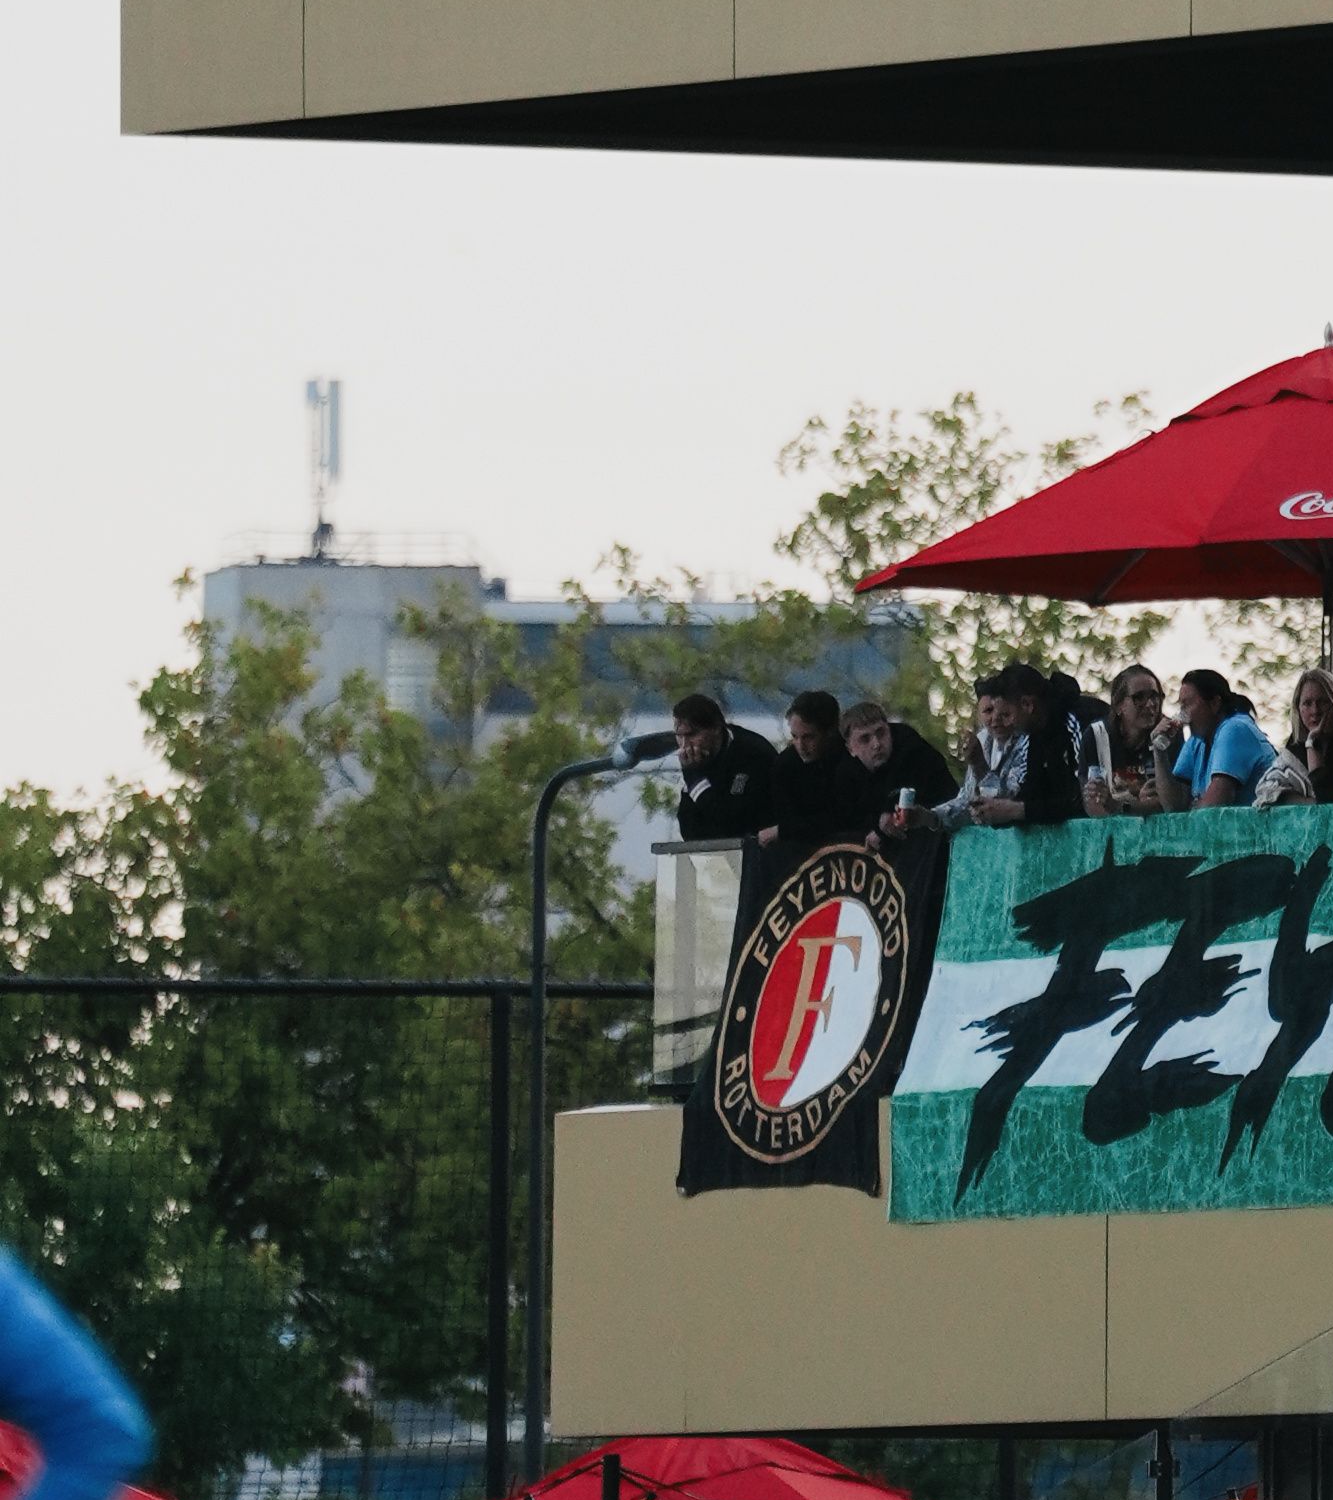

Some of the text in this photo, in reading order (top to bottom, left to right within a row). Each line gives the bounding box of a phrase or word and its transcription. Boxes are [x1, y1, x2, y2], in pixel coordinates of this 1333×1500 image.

[753, 853, 903, 968] FEYENOORD
[762, 935, 863, 1082] F
[724, 1047, 871, 1150] ROTTERDAM
